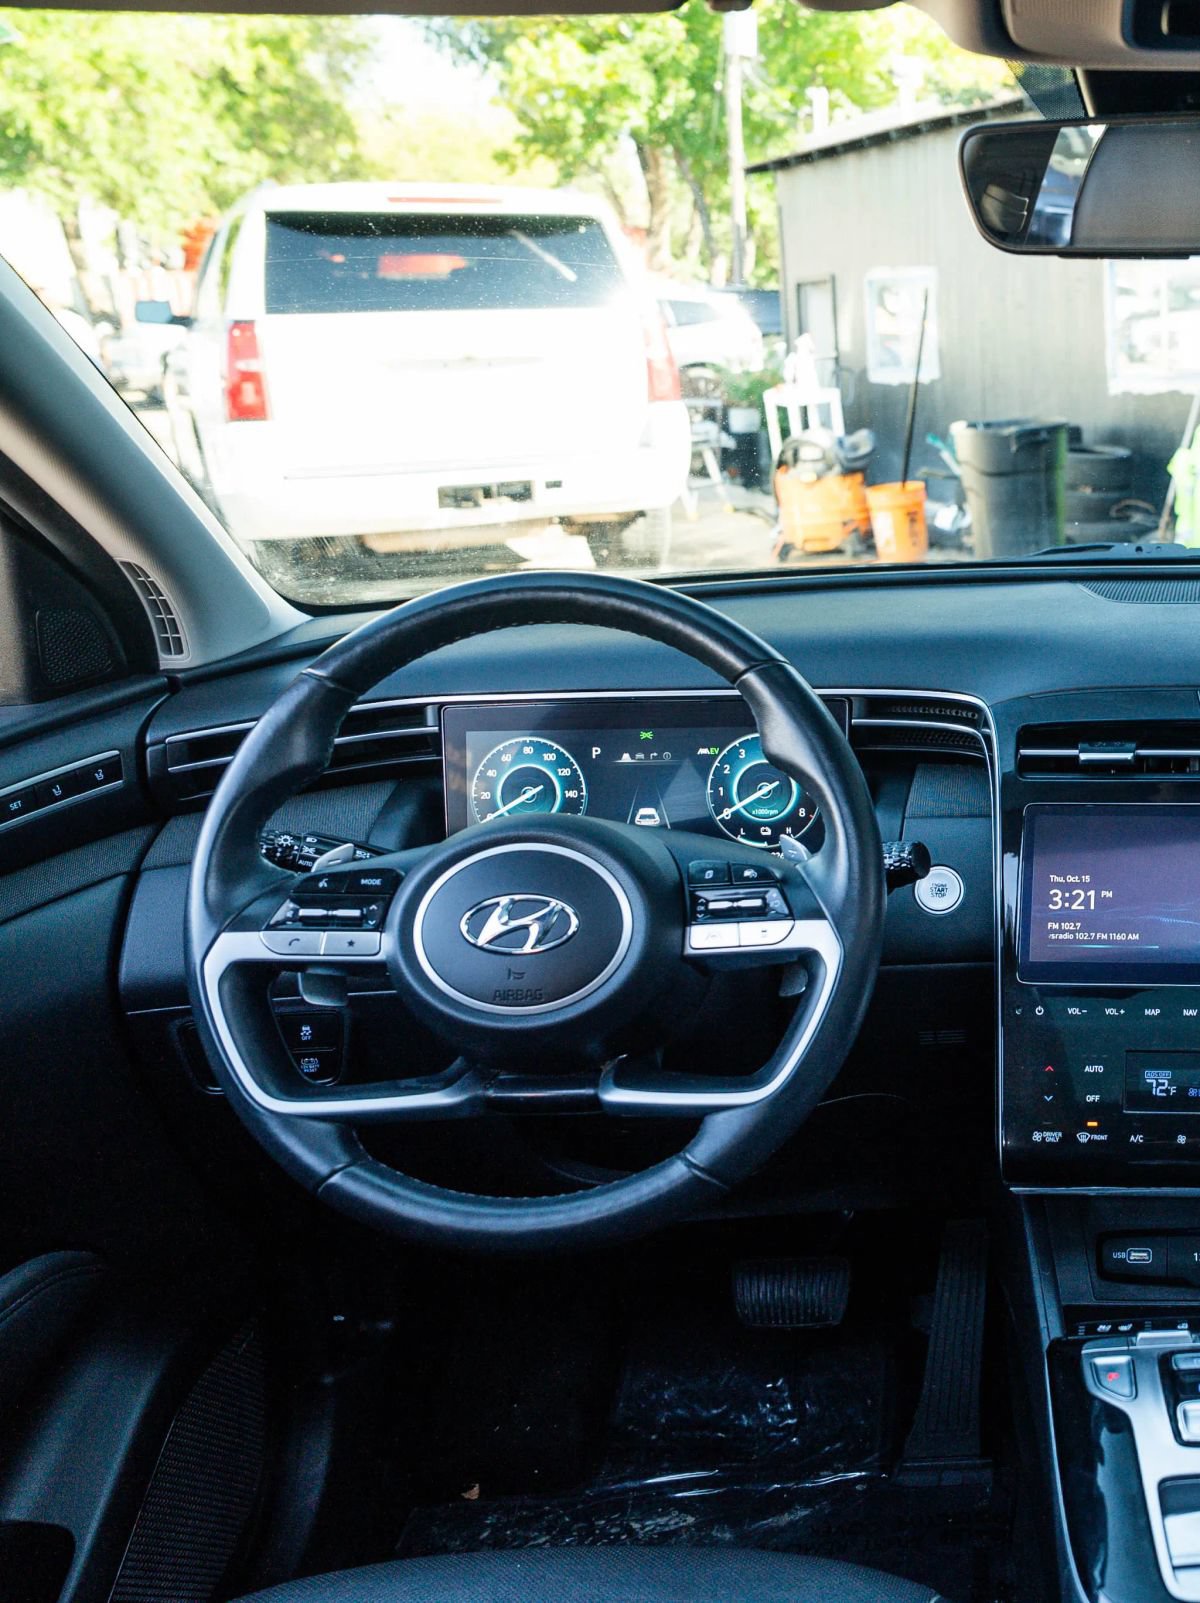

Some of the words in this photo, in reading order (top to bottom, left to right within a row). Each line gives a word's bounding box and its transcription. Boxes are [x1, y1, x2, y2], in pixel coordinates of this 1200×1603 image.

[523, 747, 534, 755] 80
[592, 747, 601, 759] P
[739, 749, 746, 758] 3
[501, 754, 512, 762] 60
[543, 753, 556, 761] 100
[558, 768, 571, 776] 120
[723, 765, 731, 774] 2
[481, 791, 491, 799] 20
[719, 787, 724, 796] 1
[9, 801, 22, 811] SET
[799, 808, 806, 817] 8
[298, 859, 313, 867] AUTO
[1050, 875, 1065, 883] Thu,
[1082, 875, 1090, 883] 15
[1048, 889, 1095, 910] 3:21
[1101, 890, 1112, 898] PM
[1048, 922, 1059, 930] FM
[1061, 922, 1081, 930] 102.7
[493, 988, 543, 1000] AIRBAG
[1144, 1008, 1161, 1016] MAP
[1084, 1065, 1104, 1073] AUTO
[1129, 1135, 1144, 1143] A/C
